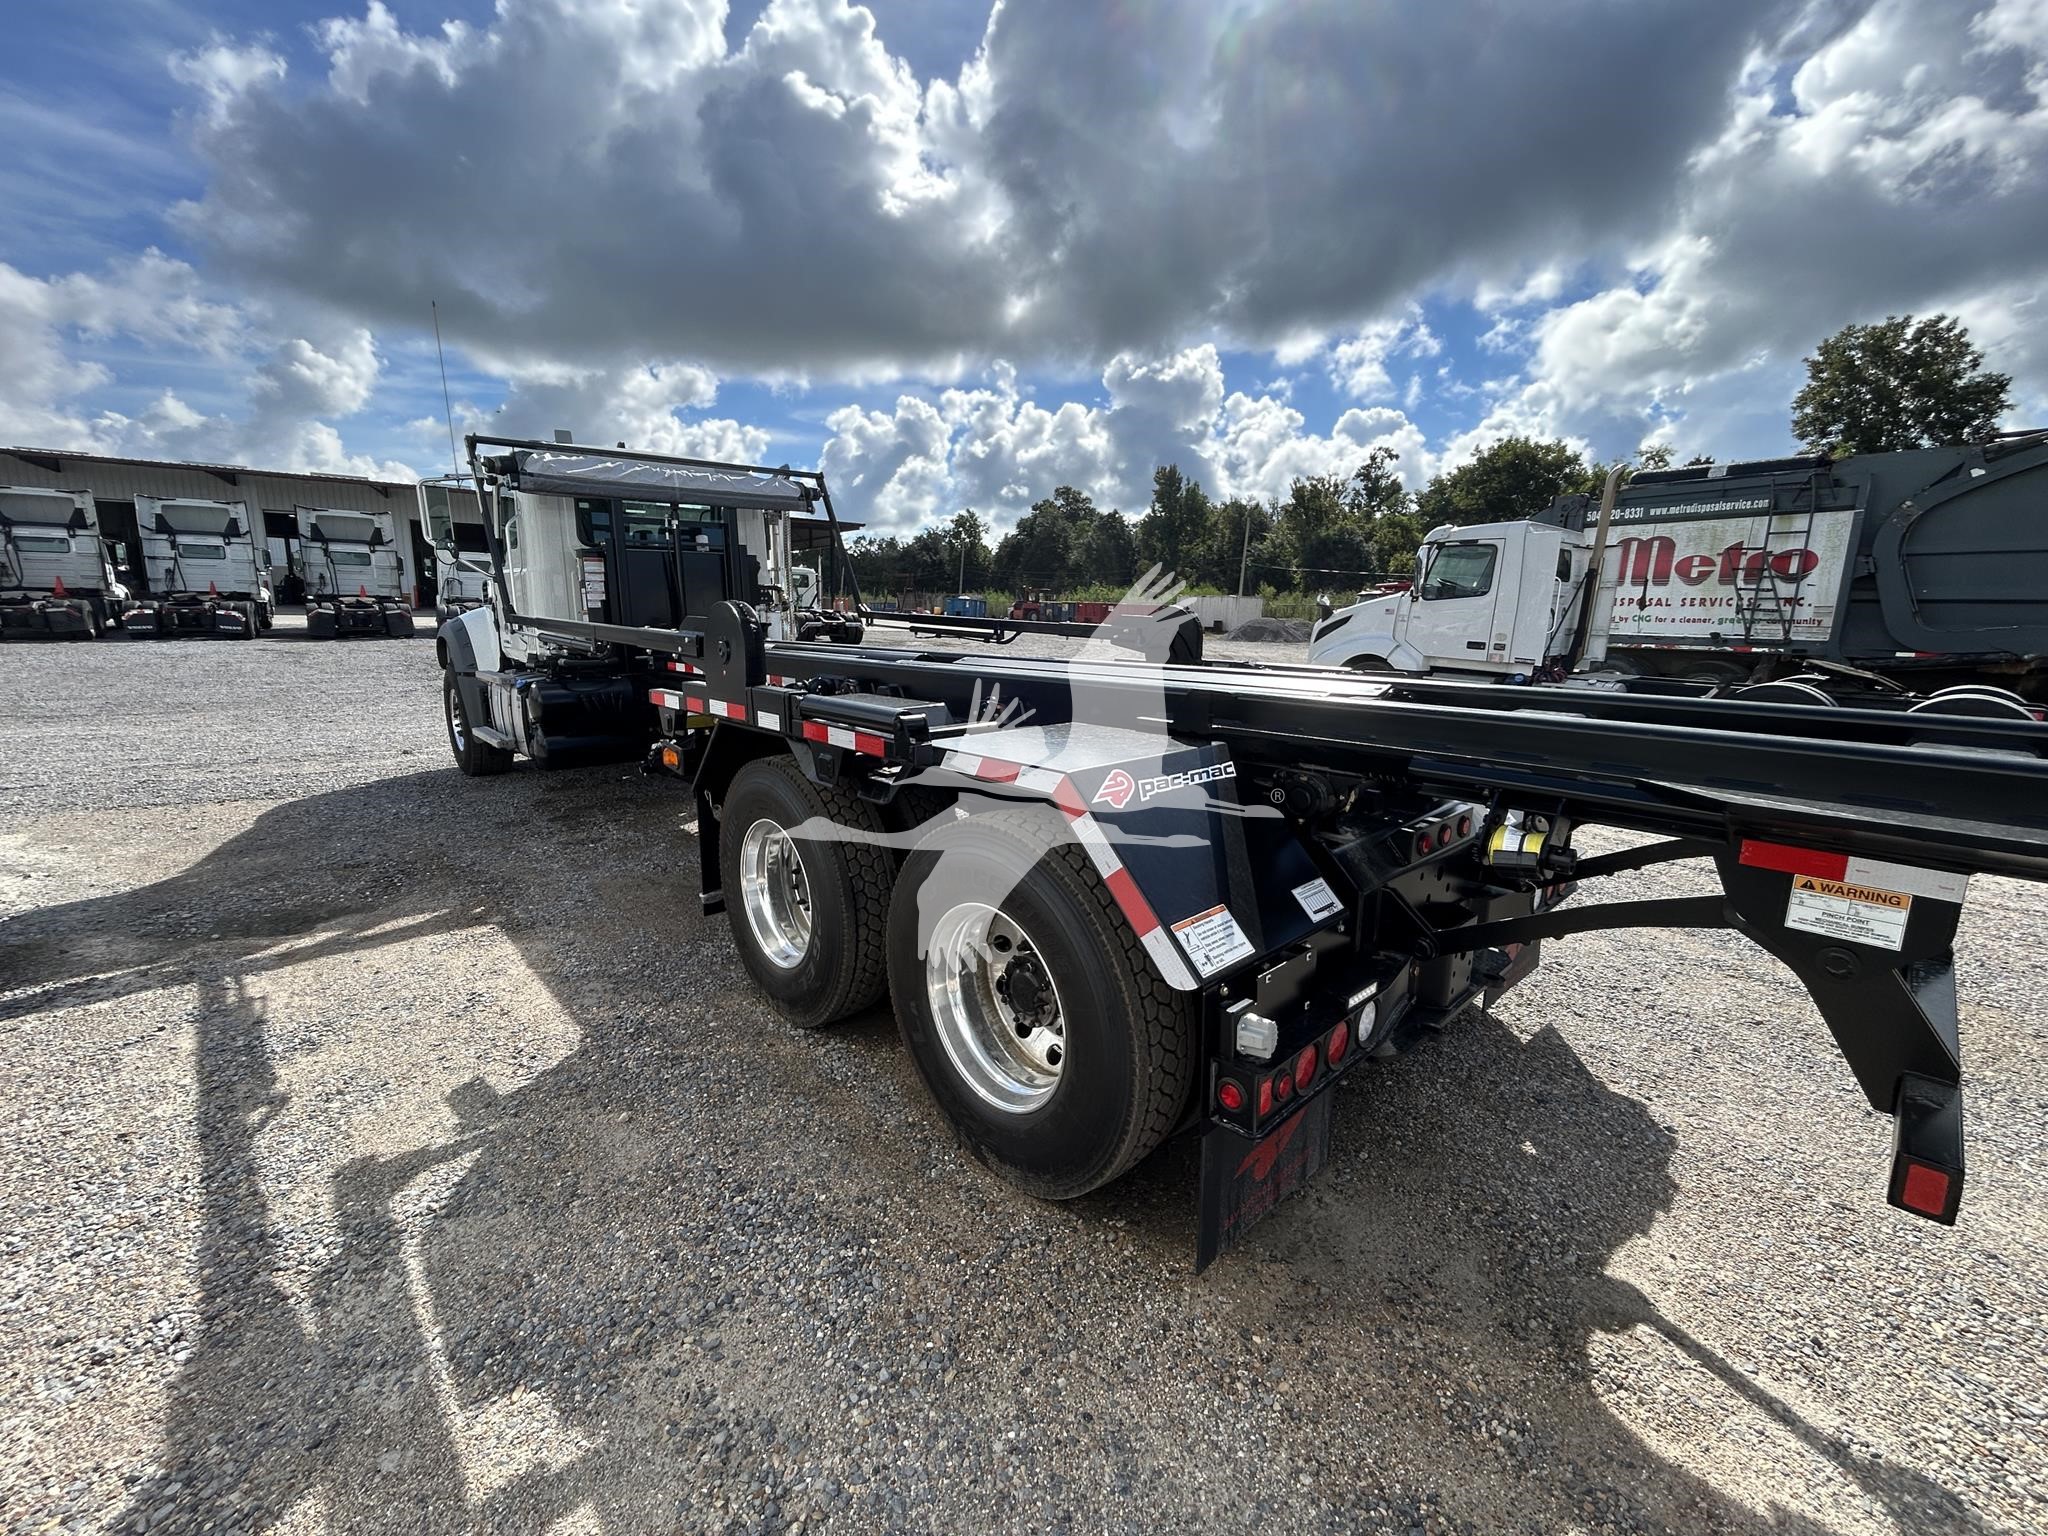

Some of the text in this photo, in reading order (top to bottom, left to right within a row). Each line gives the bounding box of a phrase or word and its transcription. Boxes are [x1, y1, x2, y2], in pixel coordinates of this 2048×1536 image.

[1586, 499, 1770, 522] 50420-8331 www.metrodisposalservice.com
[1616, 535, 1819, 587] Metro
[1613, 597, 1671, 607] ISPOSAL
[1680, 596, 1761, 608] SERVICS,
[1631, 614, 1652, 623] CNG
[1654, 615, 1667, 623] for
[1679, 616, 1715, 625] cleaner,
[1138, 761, 1237, 802] pac-mac
[1820, 882, 1901, 906] WARNING
[1822, 911, 1870, 925] PINCH POINT
